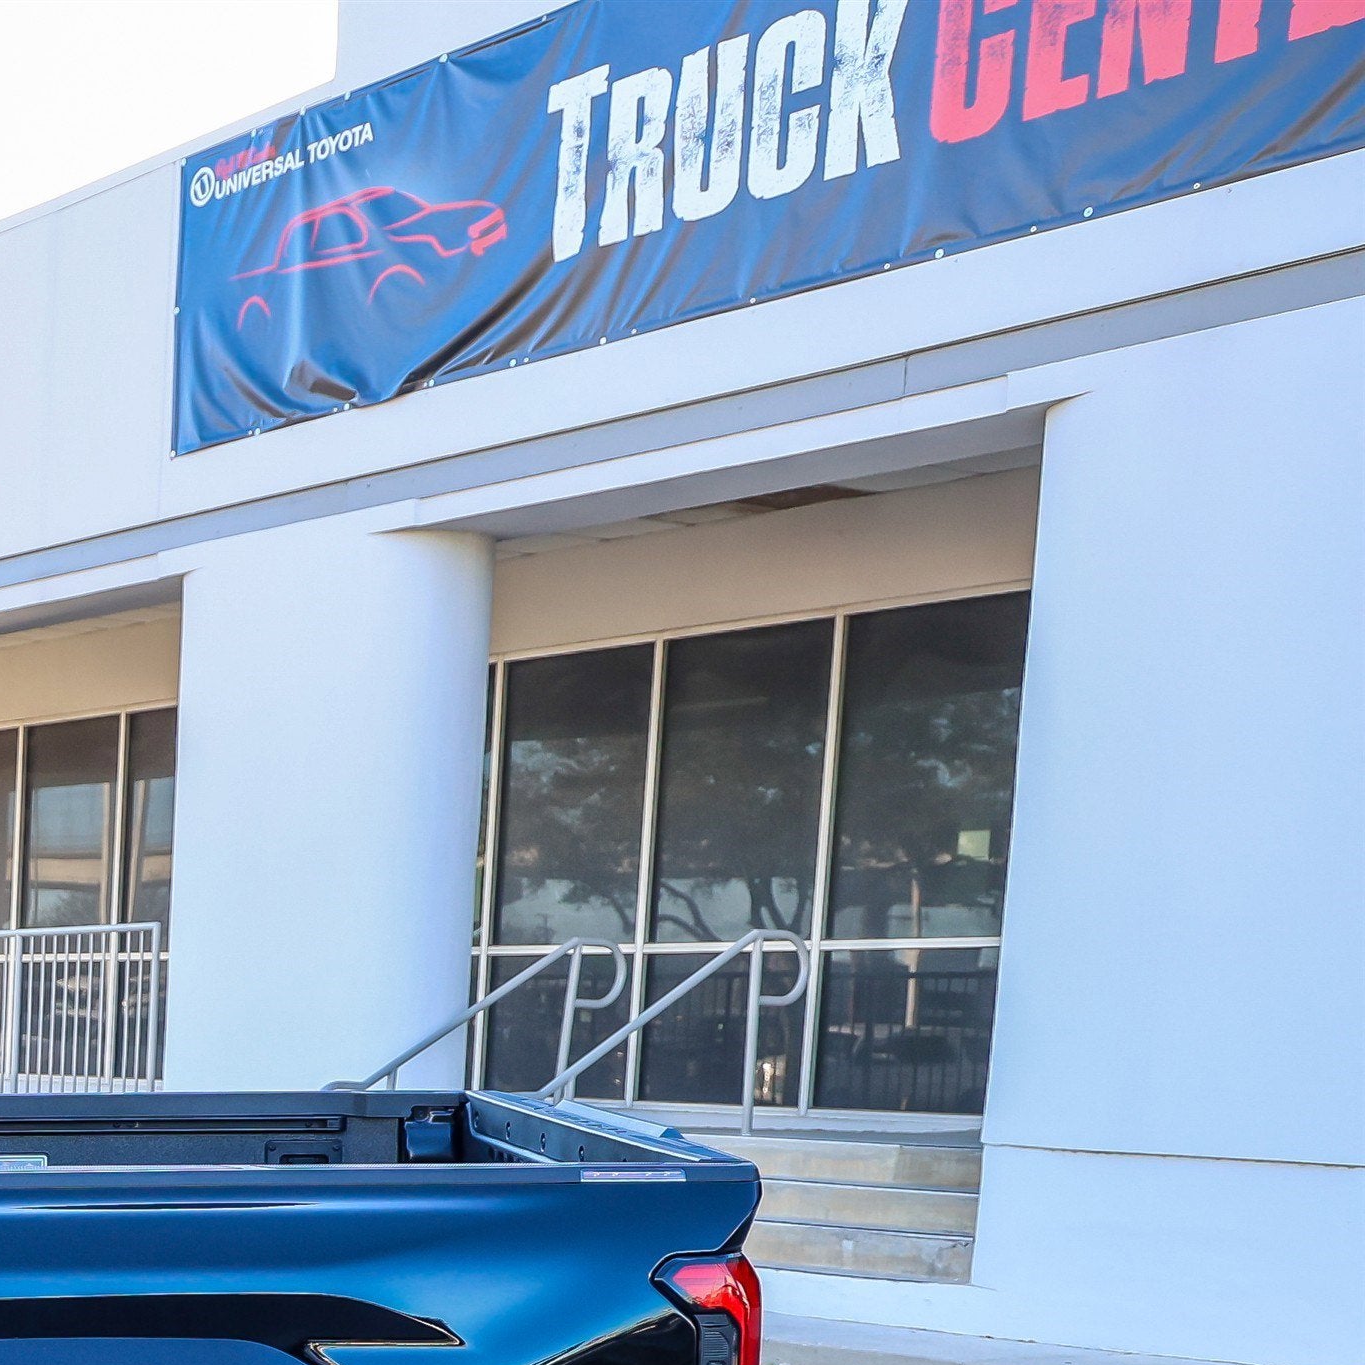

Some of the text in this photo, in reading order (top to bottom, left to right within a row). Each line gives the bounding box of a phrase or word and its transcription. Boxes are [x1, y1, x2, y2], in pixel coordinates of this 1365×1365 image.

[215, 148, 305, 199] UNIVERSAL
[307, 122, 374, 163] TOYOTA
[547, 0, 1365, 263] TRUCK CEN
